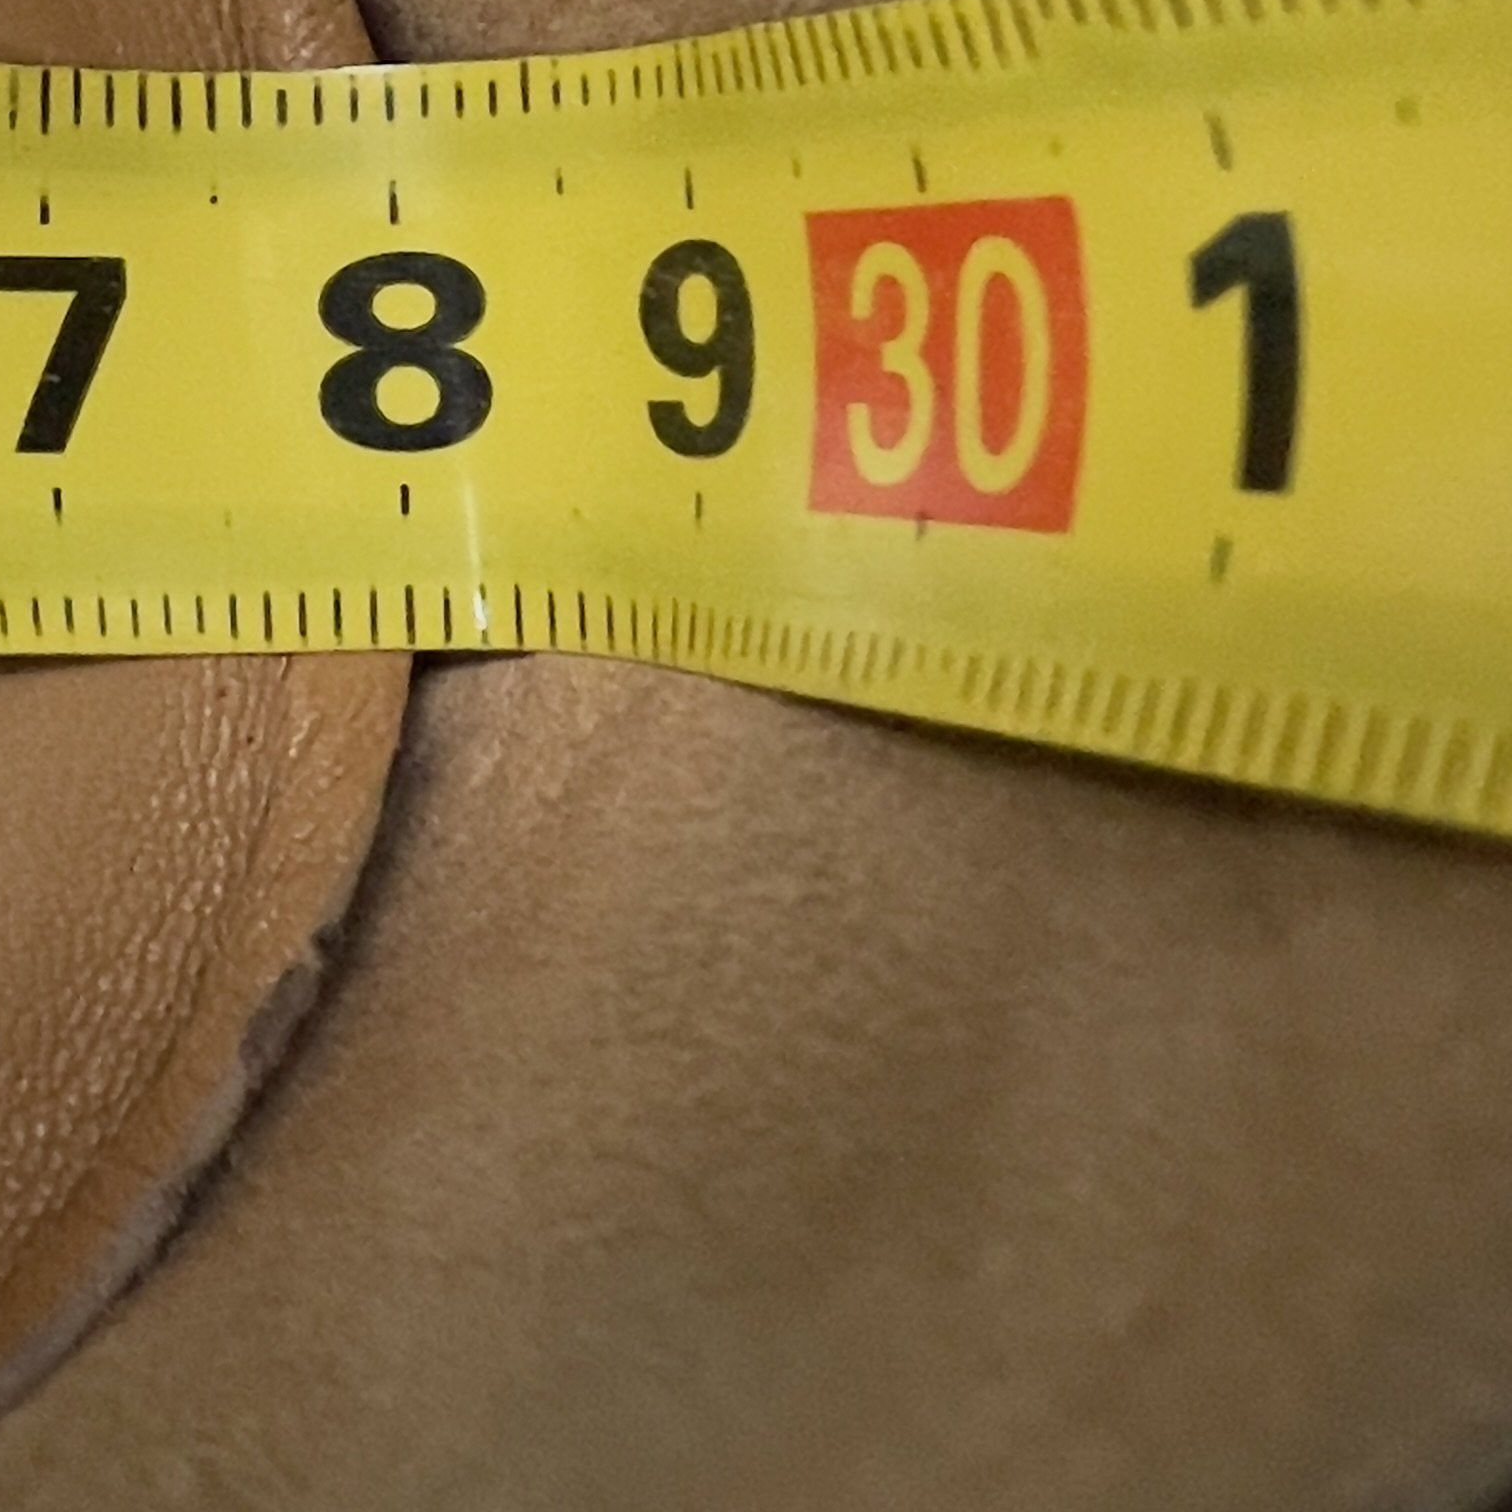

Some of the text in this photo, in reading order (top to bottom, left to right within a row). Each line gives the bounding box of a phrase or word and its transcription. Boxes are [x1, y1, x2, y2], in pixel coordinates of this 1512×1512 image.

[318, 251, 494, 453] 8
[638, 238, 756, 459] 9
[847, 234, 1052, 495] 30
[1188, 211, 1303, 495] 1
